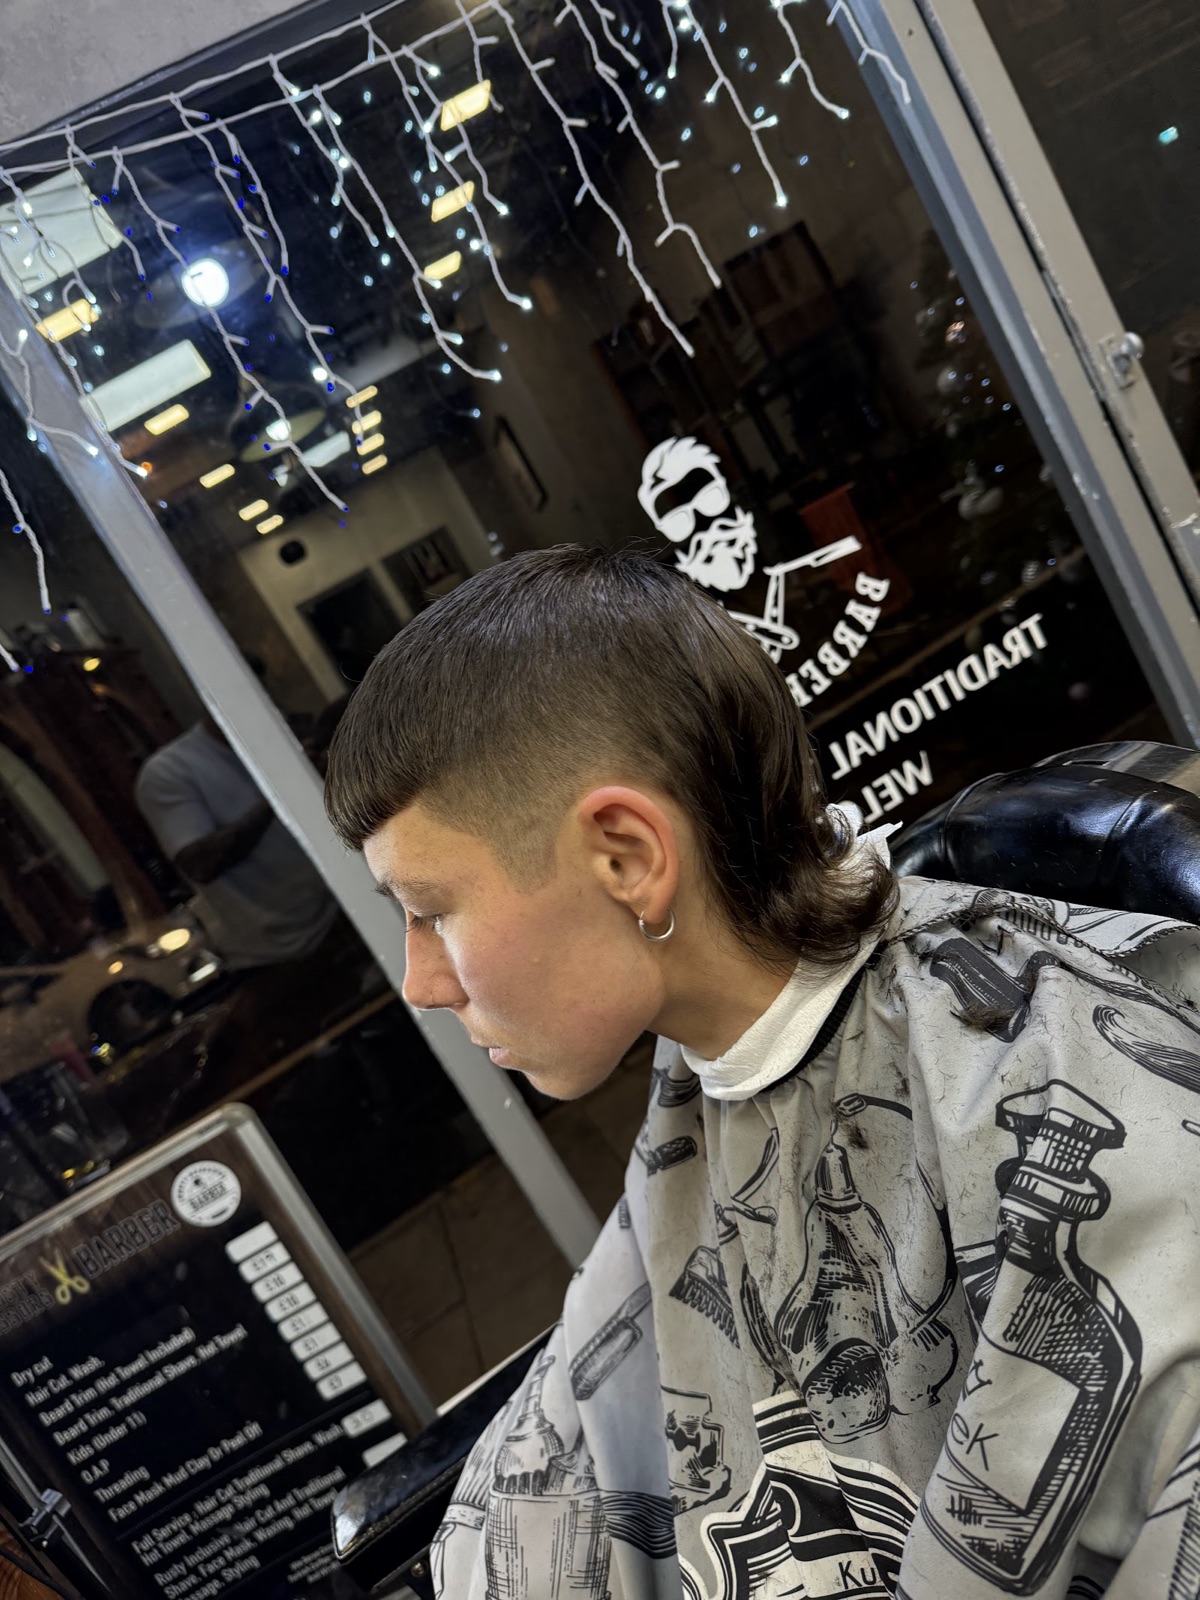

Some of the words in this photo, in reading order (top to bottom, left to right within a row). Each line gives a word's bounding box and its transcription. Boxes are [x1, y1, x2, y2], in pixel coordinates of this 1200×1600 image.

[73, 1199, 181, 1280] BARBER
[11, 1368, 35, 1387] Dry
[32, 1355, 53, 1376] cut
[25, 1387, 51, 1406] Hair
[39, 1398, 75, 1427] Beard
[69, 1387, 98, 1407] Trim
[114, 1354, 150, 1380] Towel
[110, 1371, 167, 1410] Traditional
[197, 1341, 219, 1360] Hot
[213, 1324, 247, 1349] Towel
[67, 1444, 95, 1465] Kids
[93, 1466, 151, 1503] Threading
[108, 1500, 138, 1522] Face
[133, 1482, 166, 1506] Mask
[162, 1466, 189, 1488] Mud
[185, 1454, 212, 1475] Clay
[207, 1446, 224, 1461] Or
[220, 1431, 248, 1452] Peel
[131, 1533, 156, 1554] Full
[151, 1512, 193, 1542] Service
[194, 1496, 218, 1515] Hair
[215, 1483, 238, 1503] Cut
[232, 1455, 286, 1491] Traditional
[140, 1548, 163, 1566] Hot
[188, 1503, 236, 1535] Massage
[231, 1483, 271, 1509] Styling
[153, 1562, 187, 1586] Rusty
[183, 1533, 232, 1567] Inclusive
[254, 1505, 277, 1523] Cut
[273, 1493, 297, 1513] And
[291, 1466, 346, 1502] Traditional
[197, 1555, 227, 1577] Face
[292, 1503, 313, 1520] Hot
[221, 1555, 261, 1582] Styling
